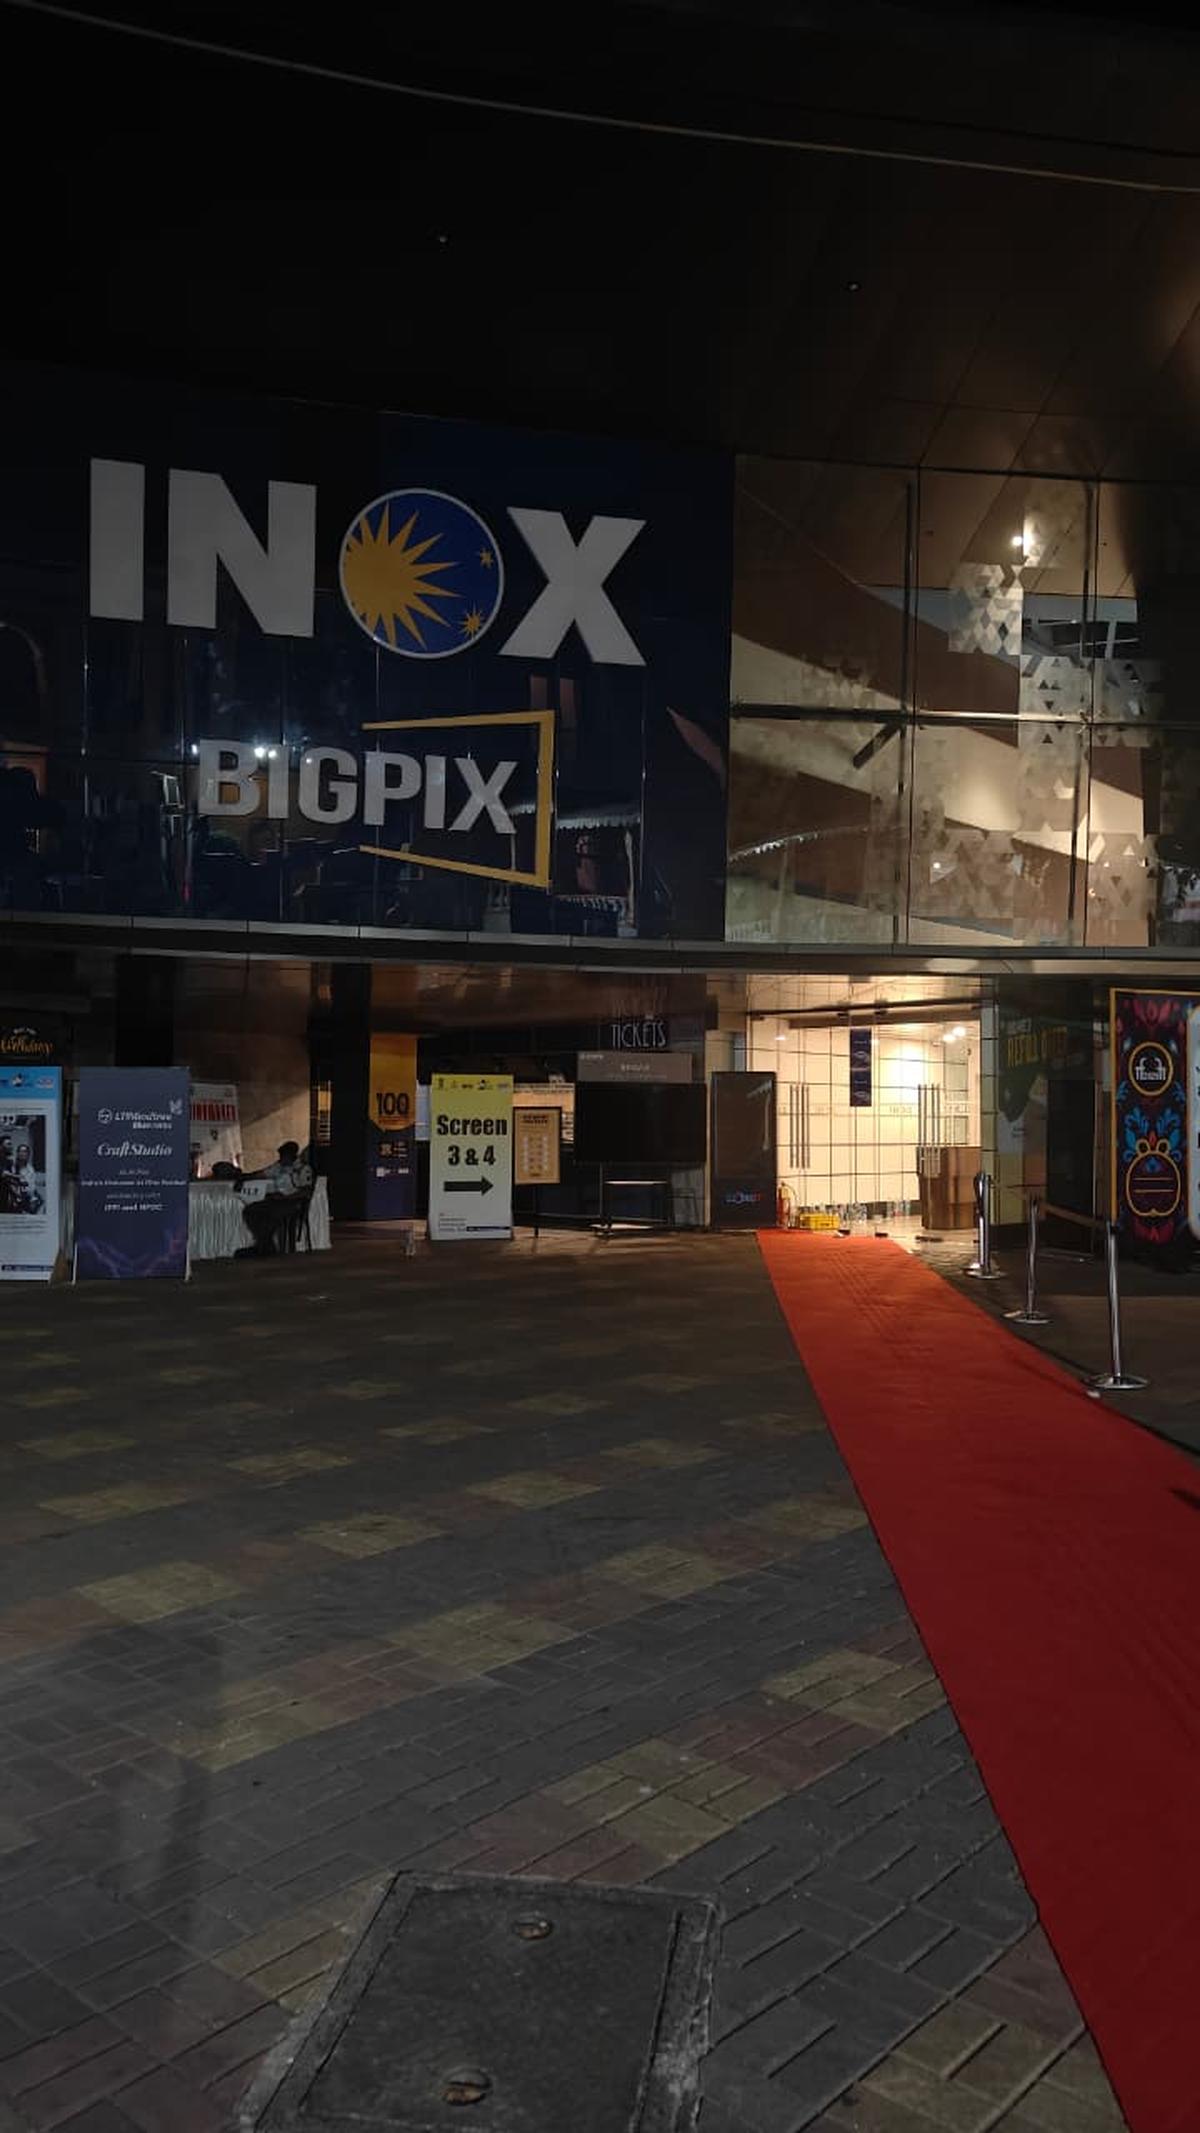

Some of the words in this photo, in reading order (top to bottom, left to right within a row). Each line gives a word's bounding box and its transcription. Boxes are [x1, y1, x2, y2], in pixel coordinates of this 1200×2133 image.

[89, 457, 646, 666] INOX
[198, 739, 517, 835] BIGPIX
[611, 1020, 667, 1049] TICKETS
[376, 1092, 410, 1116] 100
[437, 1115, 507, 1135] Screen
[448, 1145, 461, 1166] 3
[465, 1149, 478, 1165] &
[483, 1145, 496, 1166] 4
